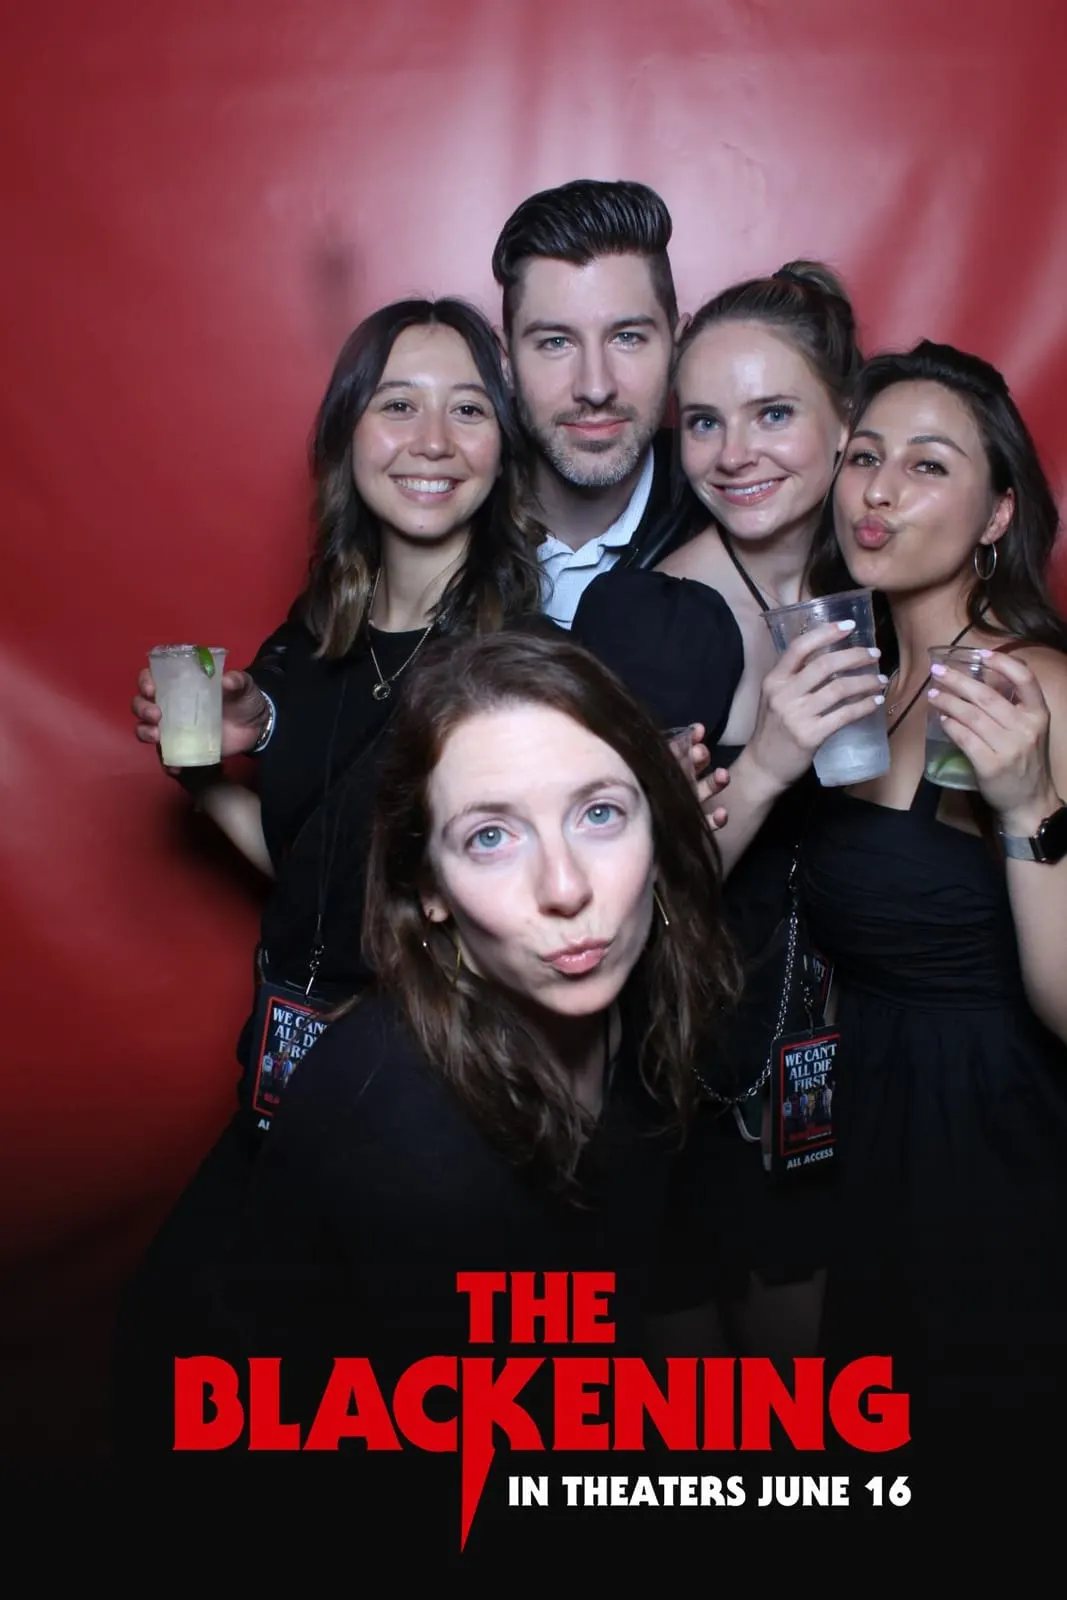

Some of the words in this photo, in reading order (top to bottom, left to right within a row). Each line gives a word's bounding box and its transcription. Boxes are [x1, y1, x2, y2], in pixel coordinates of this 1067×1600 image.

[273, 1007, 294, 1026] WE
[785, 1052, 803, 1068] WE
[789, 1064, 811, 1080] ALL
[813, 1058, 833, 1074] DIE
[794, 1073, 827, 1092] FIRST
[787, 1156, 802, 1170] ALL
[803, 1147, 834, 1165] ACCESS
